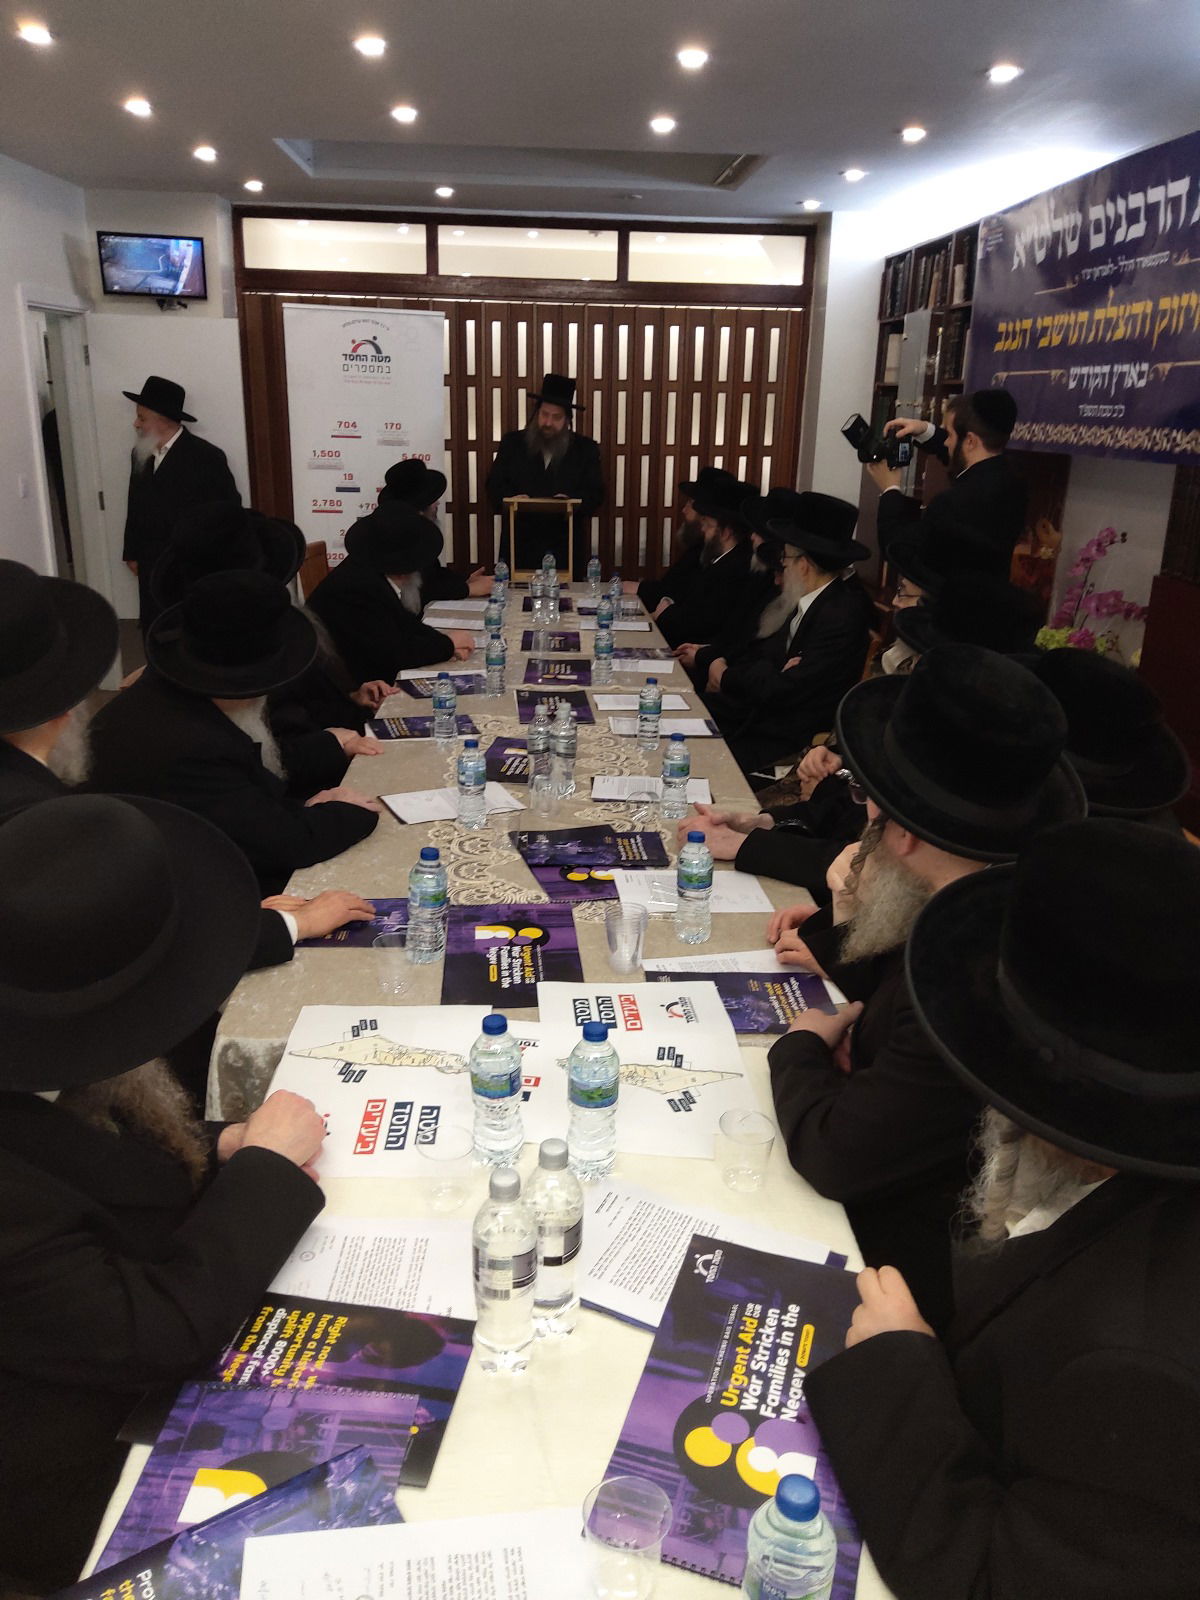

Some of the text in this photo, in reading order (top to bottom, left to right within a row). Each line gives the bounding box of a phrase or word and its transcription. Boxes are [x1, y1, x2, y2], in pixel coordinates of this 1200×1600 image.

[1088, 174, 1191, 252] הרבנים
[1037, 310, 1089, 350] תושבי
[1086, 285, 1153, 345] והצלת
[993, 318, 1034, 353] הנגב
[342, 353, 392, 363] מטה החסד
[342, 363, 392, 374] במספרים
[1068, 361, 1149, 399] בארץ הקודש
[337, 421, 358, 429] 704
[384, 422, 402, 430] 170
[312, 449, 341, 458] 1,500
[355, 1101, 385, 1153] ביעדים
[385, 1104, 412, 1149] החסד
[250, 1306, 274, 1333] from
[252, 1307, 288, 1359] displaced
[311, 1313, 334, 1340] have
[325, 1316, 348, 1344] Right
[240, 1334, 258, 1352] the
[261, 1309, 302, 1376] uplift 8000+
[272, 1311, 316, 1377] opportunity
[306, 1341, 317, 1349] a
[720, 1316, 759, 1407] Urgent Aid
[739, 1308, 780, 1410] War Stricken
[759, 1304, 800, 1419] Families in the
[780, 1367, 806, 1423] Negev
